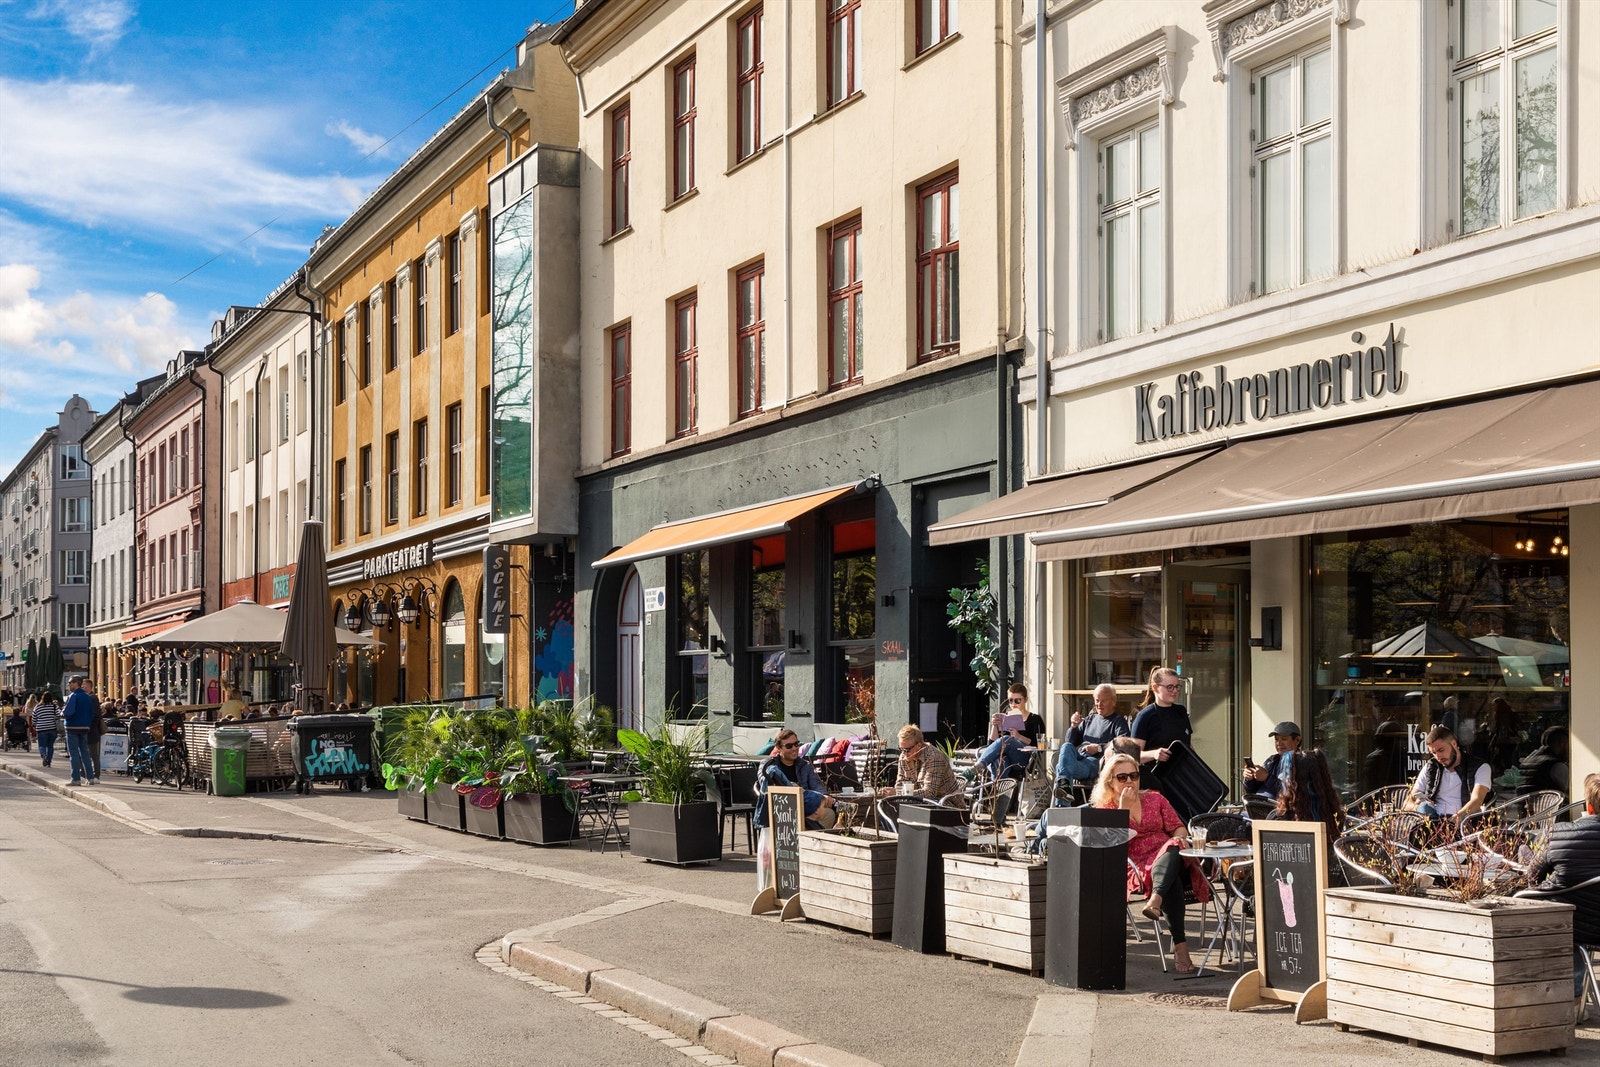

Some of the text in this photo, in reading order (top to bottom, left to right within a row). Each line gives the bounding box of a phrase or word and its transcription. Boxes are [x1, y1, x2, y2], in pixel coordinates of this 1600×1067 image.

[1134, 322, 1405, 444] Kaffebrenneriet
[363, 541, 429, 580] PARKTEATRET
[492, 556, 507, 627] SCENE
[1275, 931, 1303, 955] ICE TEA
